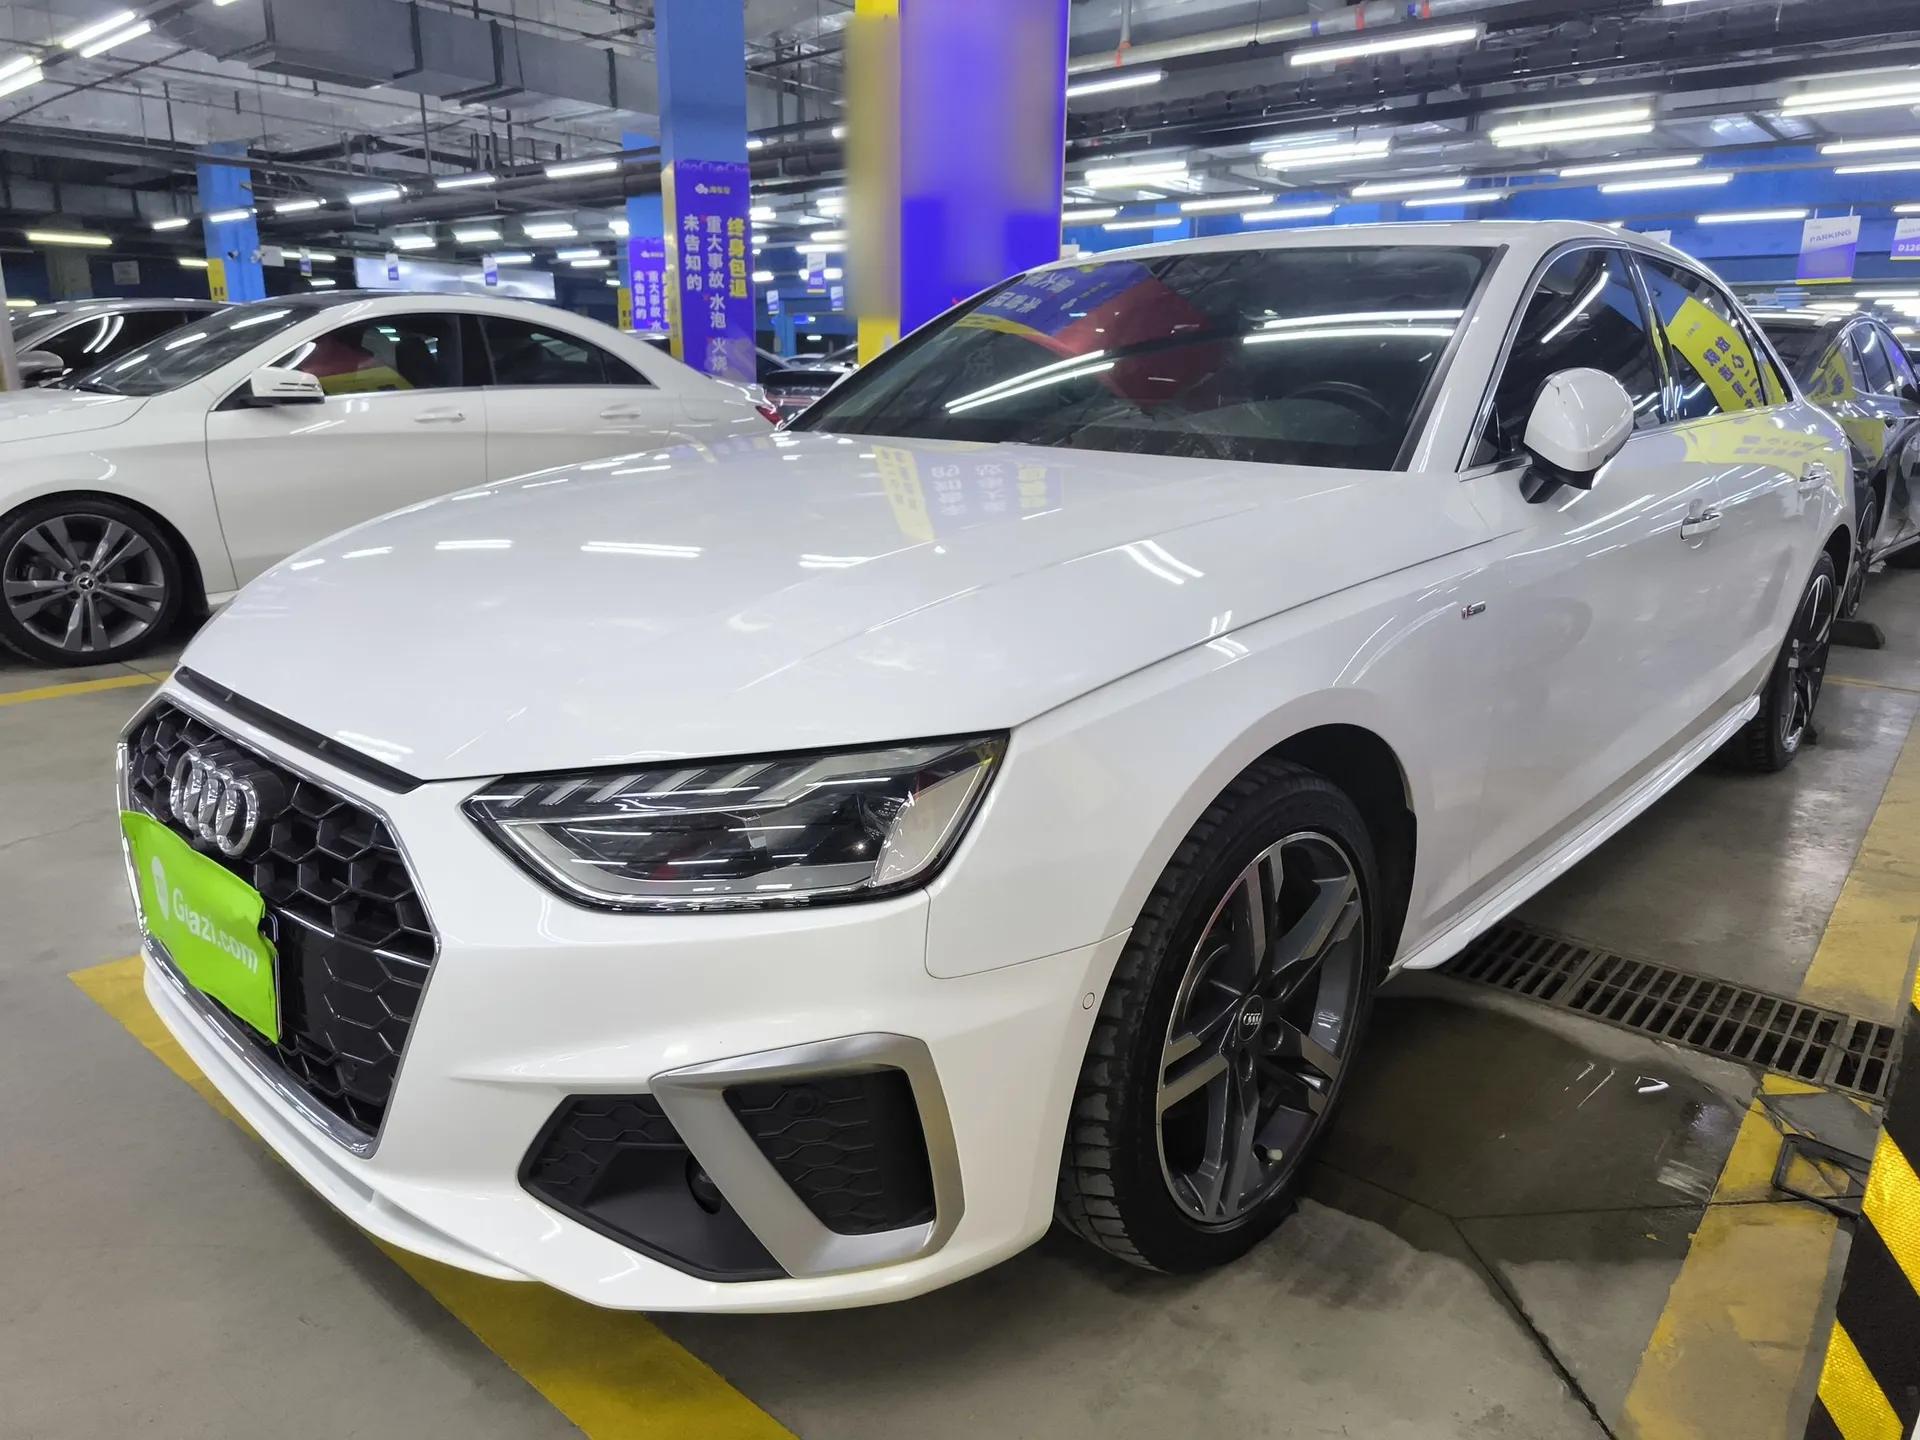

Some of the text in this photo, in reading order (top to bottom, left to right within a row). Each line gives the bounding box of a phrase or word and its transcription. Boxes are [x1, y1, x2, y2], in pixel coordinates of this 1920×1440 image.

[683, 213, 703, 291] 未告知的
[706, 215, 725, 289] 重大事故
[1809, 228, 1852, 243] PARKING
[709, 292, 727, 330] 水泡
